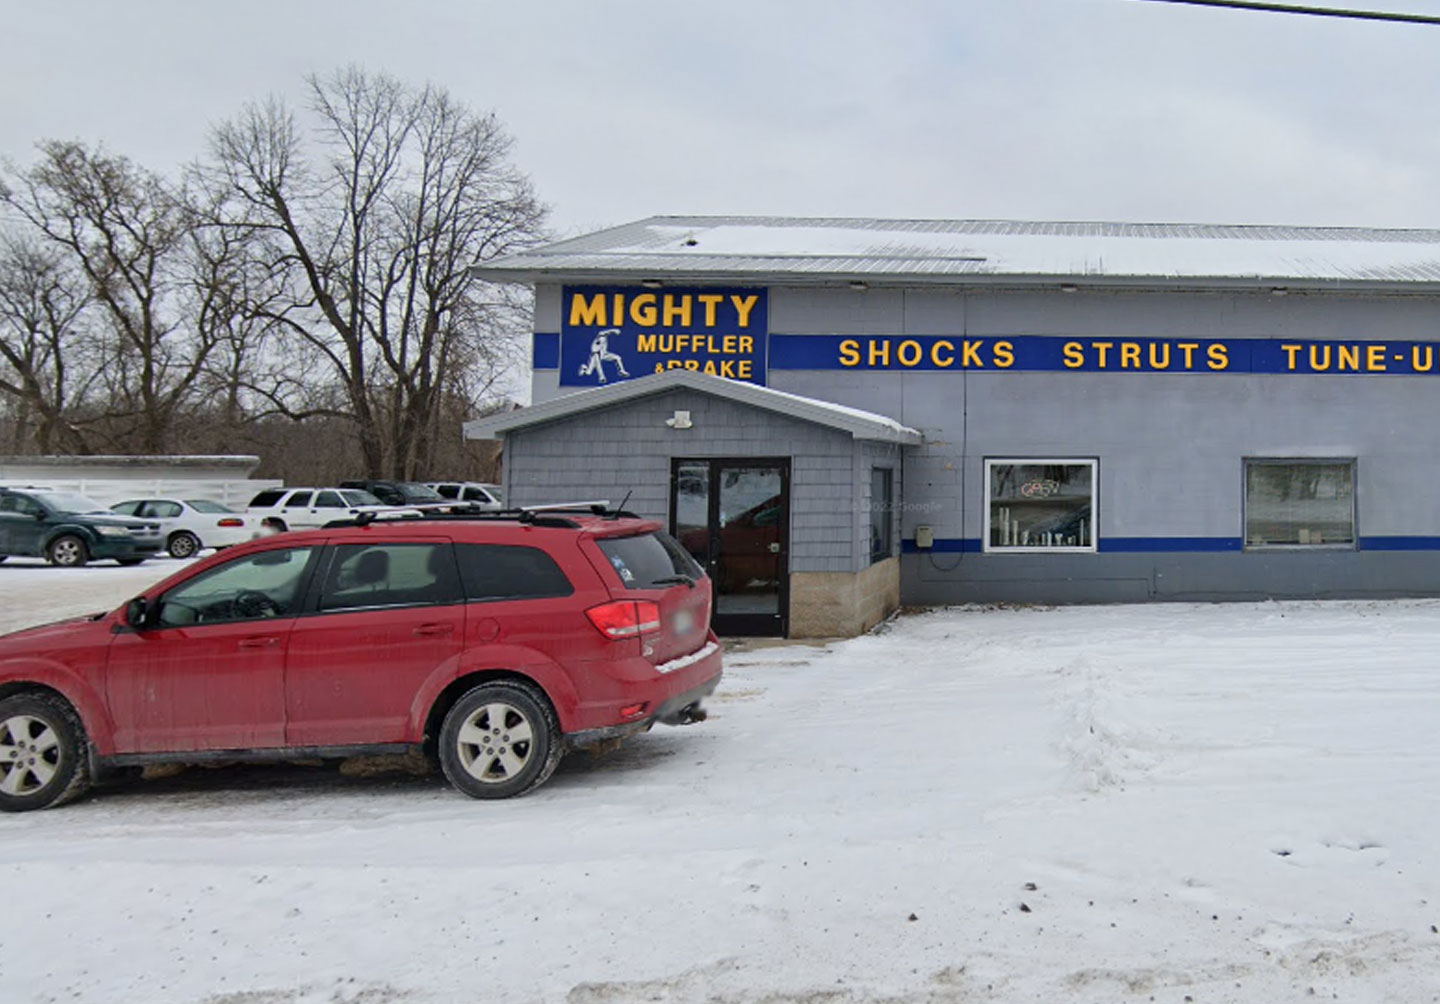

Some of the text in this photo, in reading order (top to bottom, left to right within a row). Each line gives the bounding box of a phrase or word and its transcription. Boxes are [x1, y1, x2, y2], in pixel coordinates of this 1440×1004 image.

[569, 293, 759, 327] MIGHTY
[636, 334, 754, 354] MUFFLER
[838, 339, 1016, 368] SHOCKS
[1062, 341, 1230, 371] STRUTS
